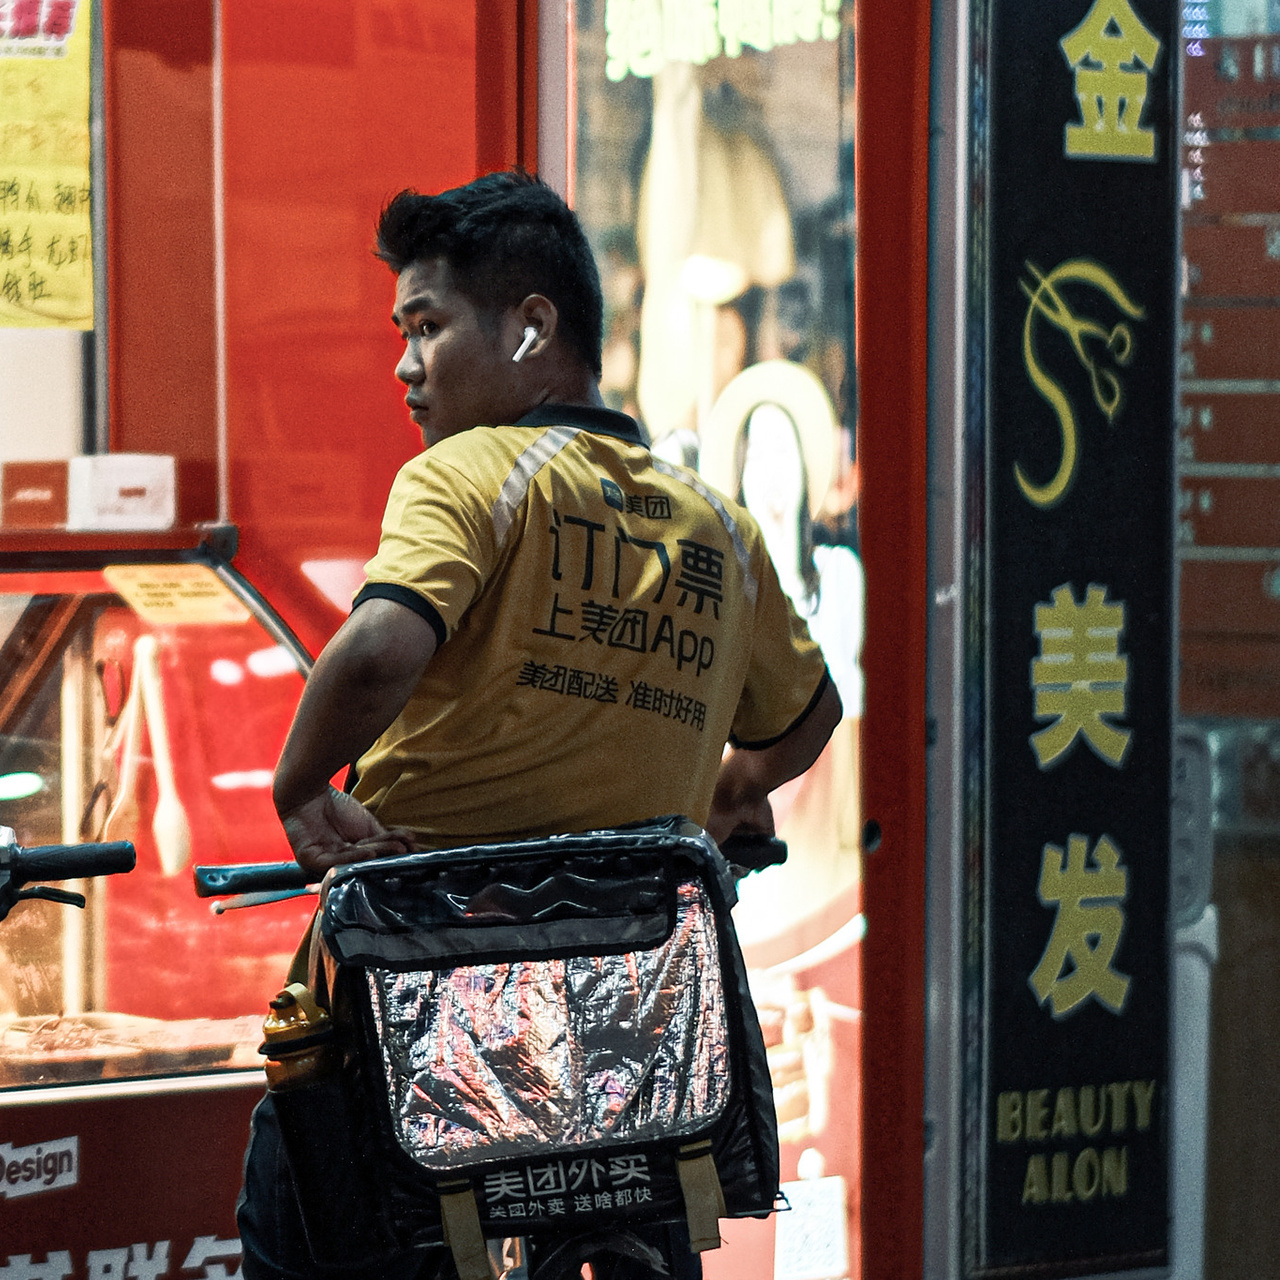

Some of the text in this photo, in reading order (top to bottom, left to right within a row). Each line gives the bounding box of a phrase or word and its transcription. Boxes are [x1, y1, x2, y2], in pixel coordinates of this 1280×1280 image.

[549, 508, 724, 620] 订门票
[532, 593, 714, 676] 上美团App
[516, 661, 707, 732] 美团配送 准时好用
[997, 1080, 1155, 1143] BEAUTY
[489, 1187, 653, 1219] 美团外卖 送啥都快
[1022, 1145, 1128, 1204] ALON
